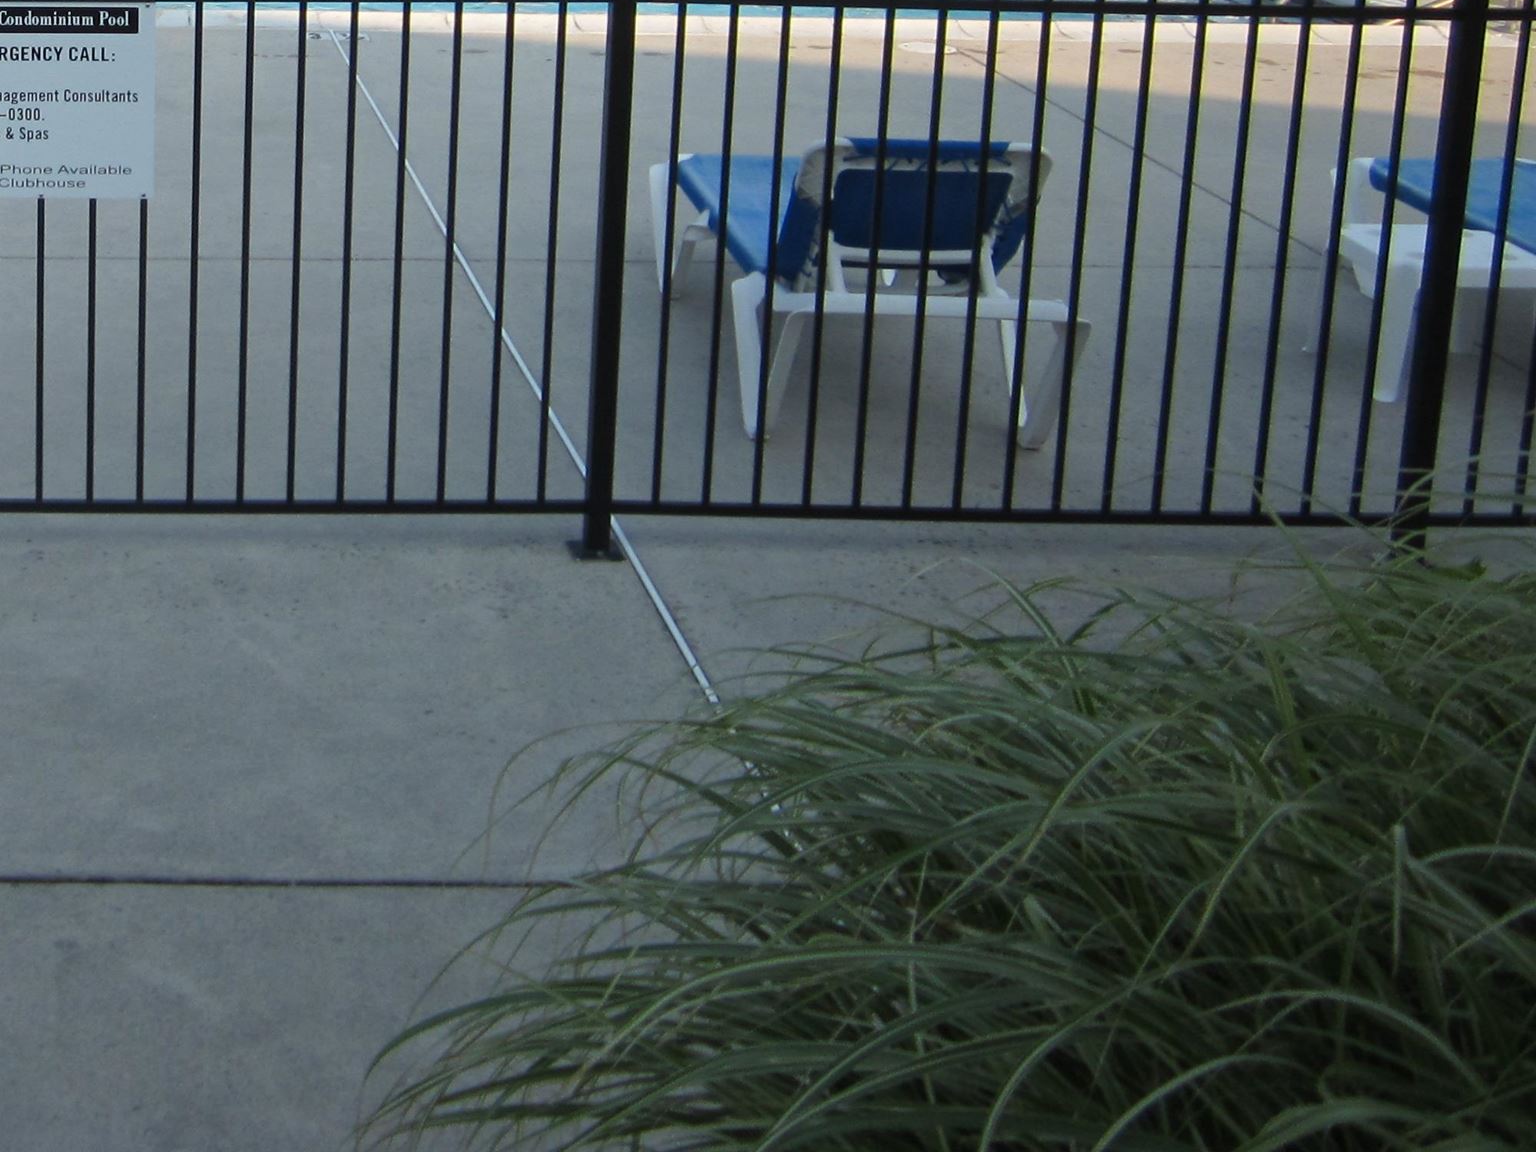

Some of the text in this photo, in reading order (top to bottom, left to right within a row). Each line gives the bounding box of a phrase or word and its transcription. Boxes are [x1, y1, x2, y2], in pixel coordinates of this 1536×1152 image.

[99, 11, 129, 26] Pool
[69, 46, 116, 62] CALL:
[63, 89, 138, 102] Consultants
[6, 127, 14, 140] &
[19, 127, 49, 143] Spas
[0, 164, 52, 175] Phone
[57, 164, 132, 175] Available
